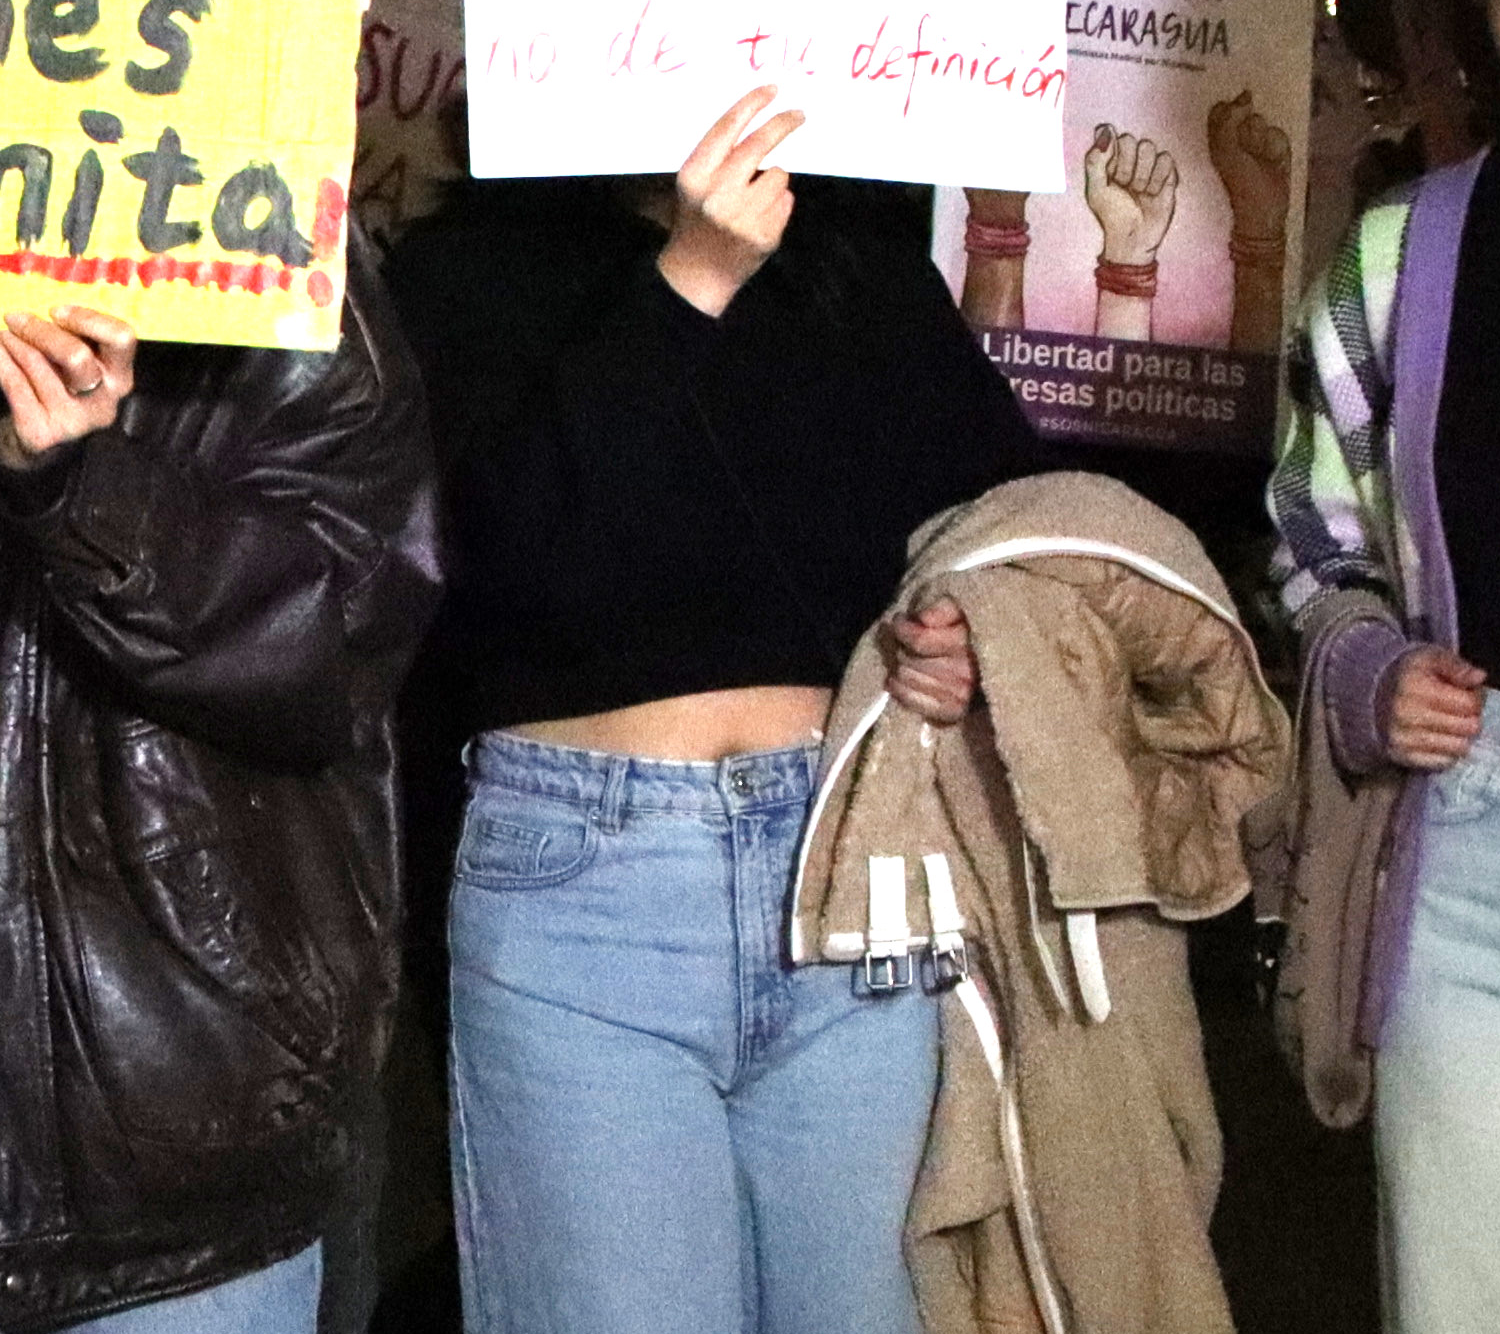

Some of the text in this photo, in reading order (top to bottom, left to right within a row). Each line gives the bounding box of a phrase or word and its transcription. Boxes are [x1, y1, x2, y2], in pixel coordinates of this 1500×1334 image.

[1066, 1, 1231, 57] ICARAGUA
[486, 0, 1067, 118] no de tu definición
[982, 331, 1246, 387] Libertad para las
[1009, 376, 1237, 421] resas políticas
